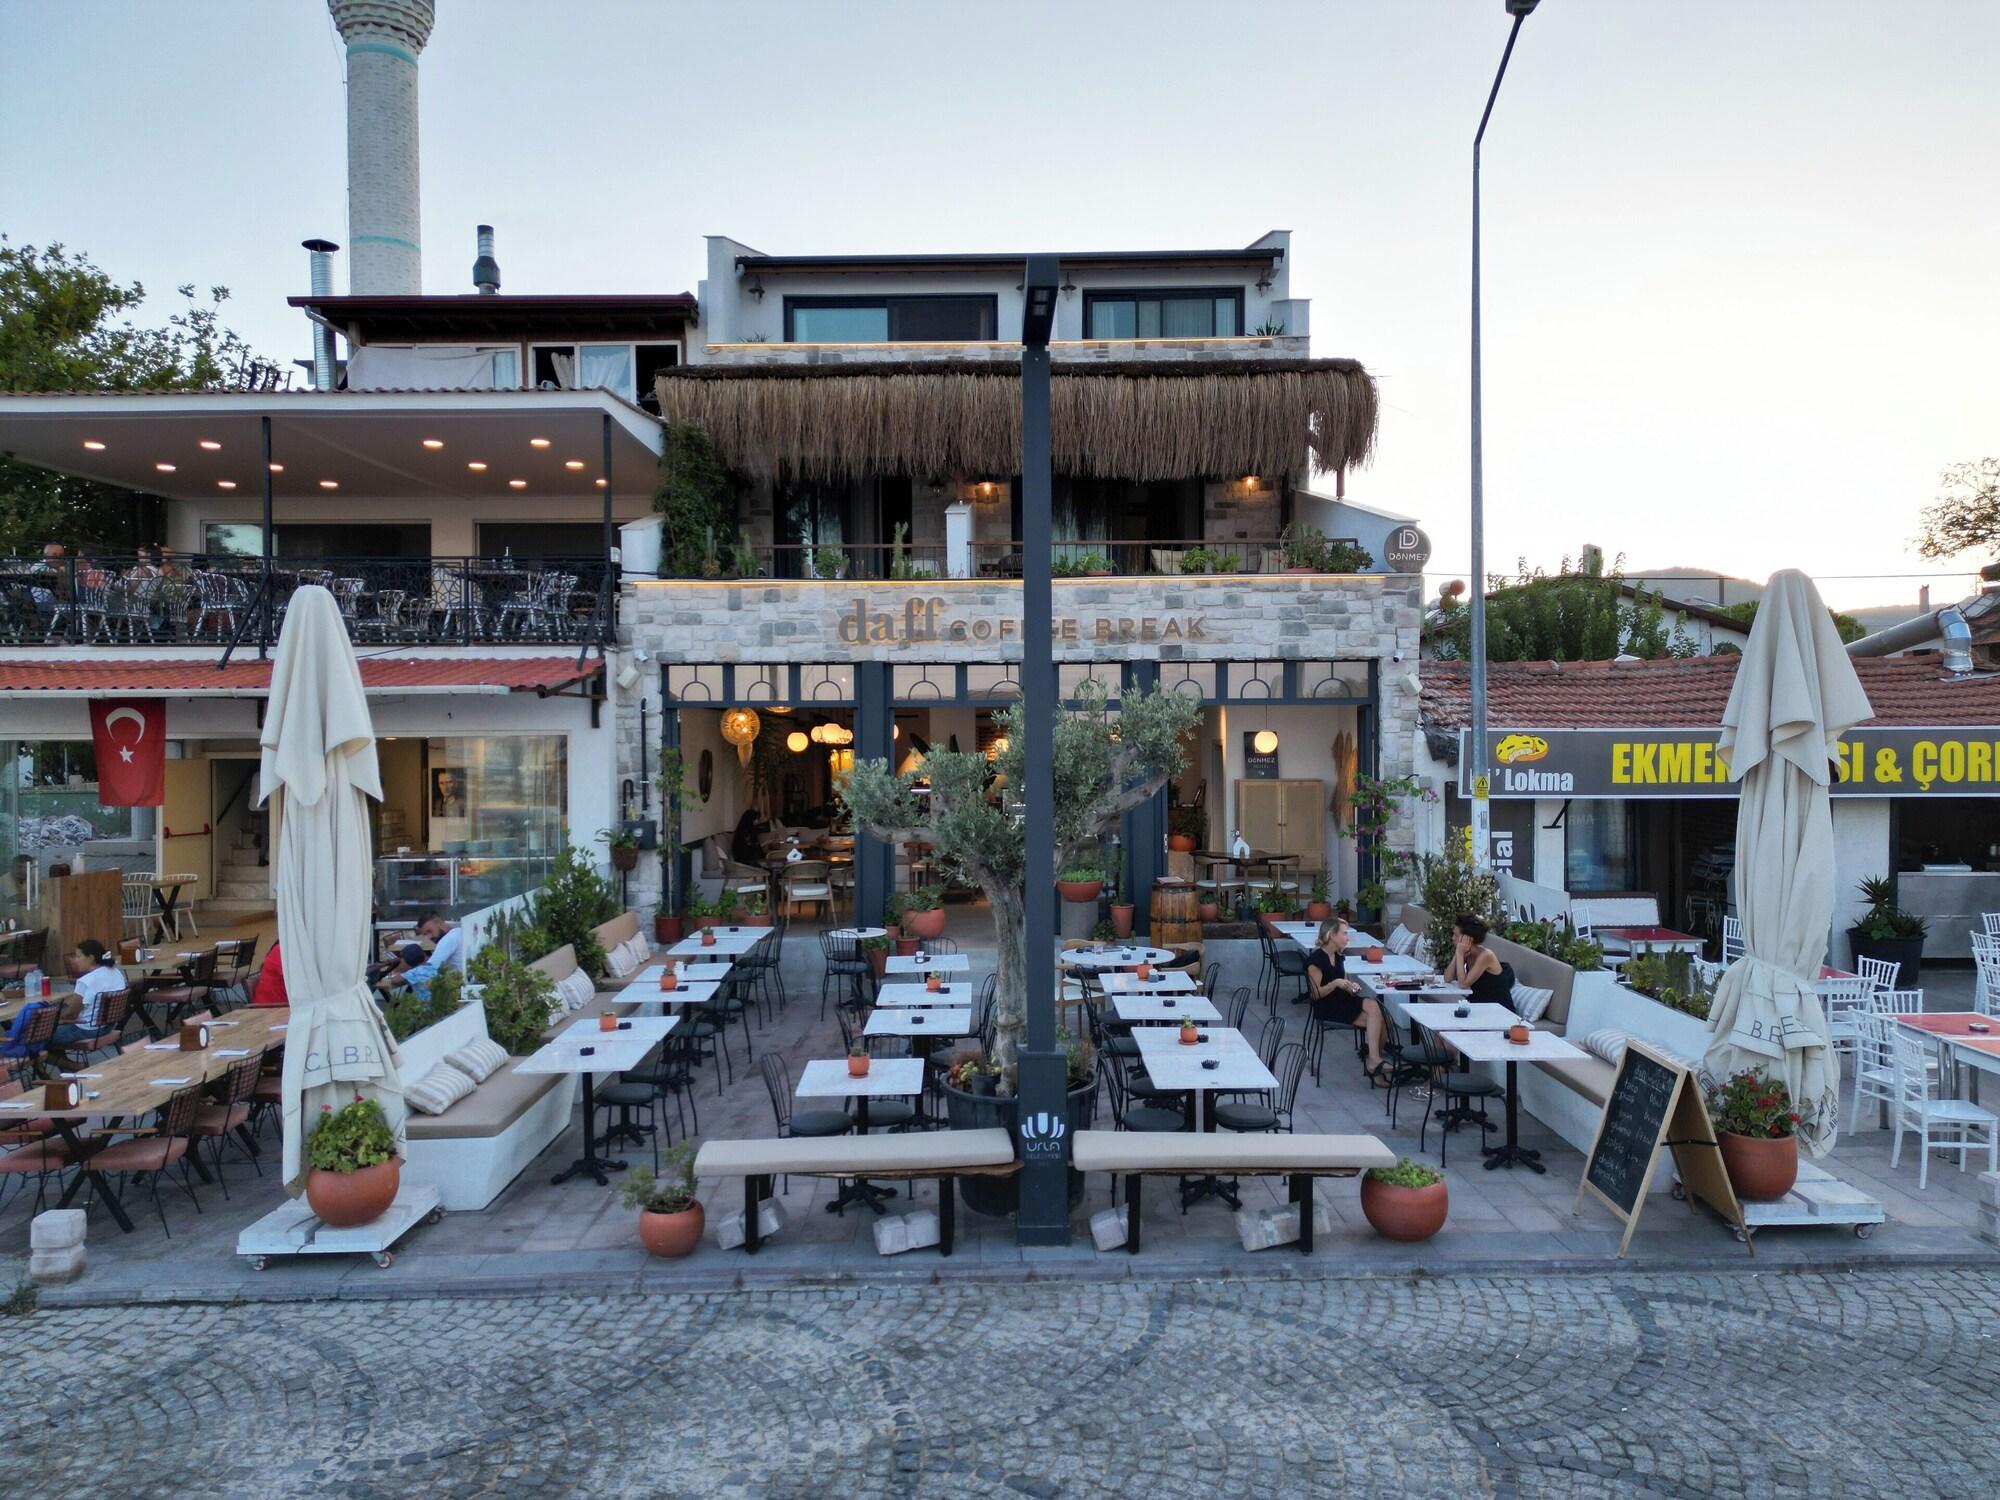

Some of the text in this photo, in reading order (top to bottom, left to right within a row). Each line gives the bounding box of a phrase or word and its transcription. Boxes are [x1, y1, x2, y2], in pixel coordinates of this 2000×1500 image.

[838, 597, 1206, 643] daff COFE BREAK
[1504, 768, 1574, 791] Lokma
[1874, 748, 1903, 783] &
[1912, 740, 2000, 791] ÇOR
